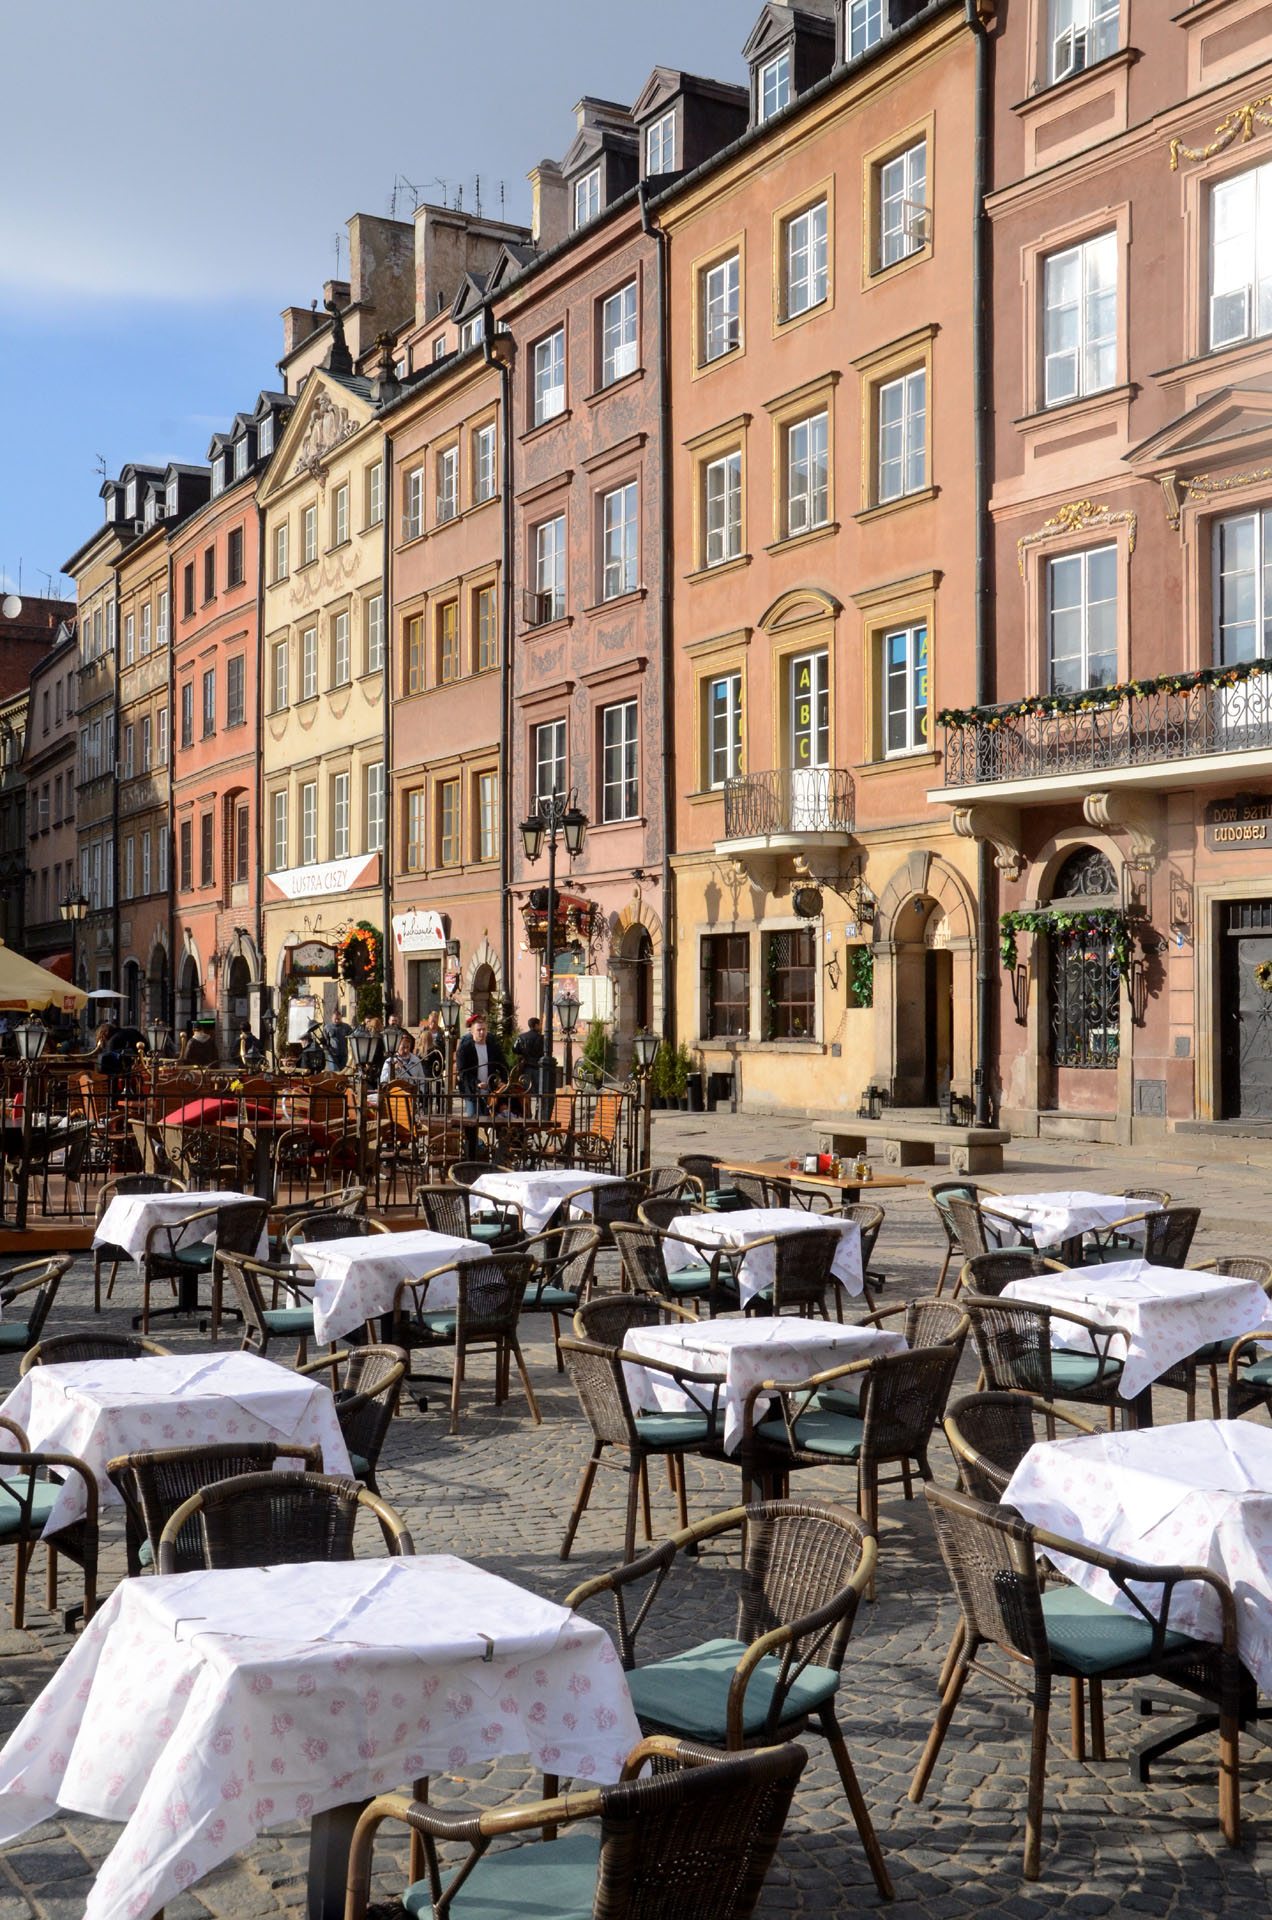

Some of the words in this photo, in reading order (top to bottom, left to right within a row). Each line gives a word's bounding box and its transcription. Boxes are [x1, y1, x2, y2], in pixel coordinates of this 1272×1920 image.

[1214, 808, 1238, 822] DOM
[1214, 825, 1266, 842] LUDOWEJ
[292, 875, 322, 894] LUSTRA
[325, 869, 348, 889] CISZY
